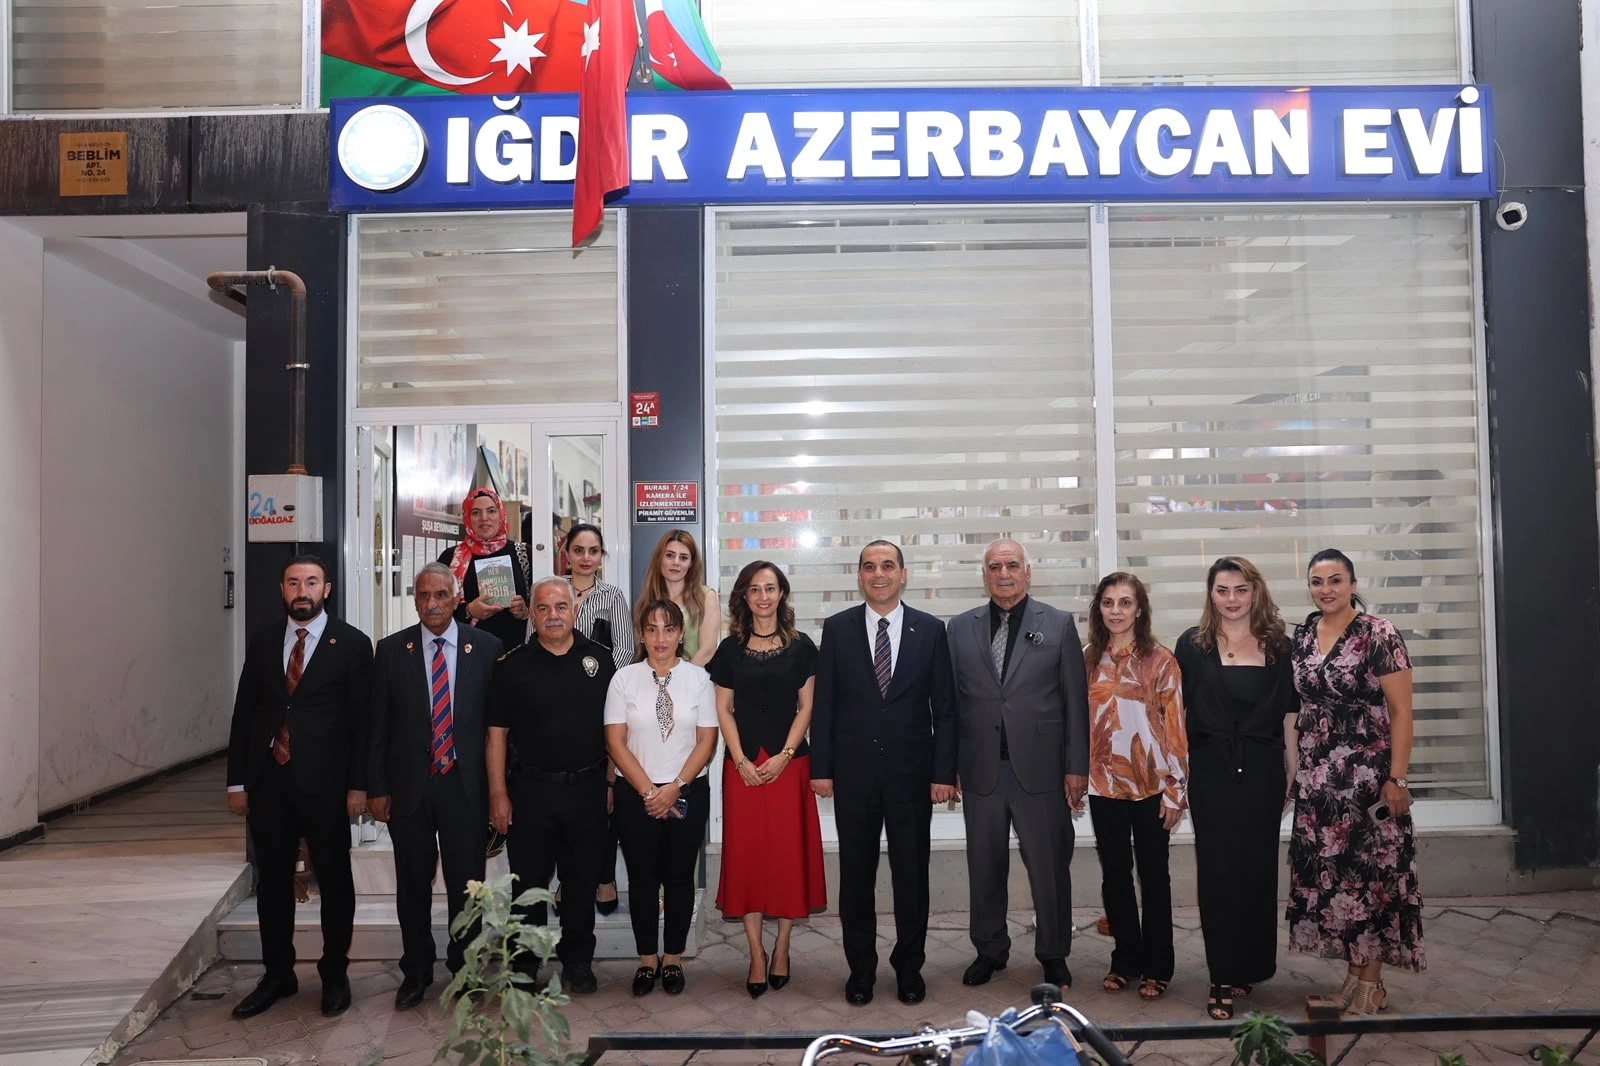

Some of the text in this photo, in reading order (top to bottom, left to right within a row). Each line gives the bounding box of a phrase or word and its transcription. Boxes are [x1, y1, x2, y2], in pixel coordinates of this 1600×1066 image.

[446, 95, 689, 183] IĞDR
[726, 109, 1310, 180] AZERBAYCAN
[1343, 86, 1484, 176] EVİ
[67, 148, 121, 161] BEBLİM
[249, 516, 294, 525] DOĞALGAZ
